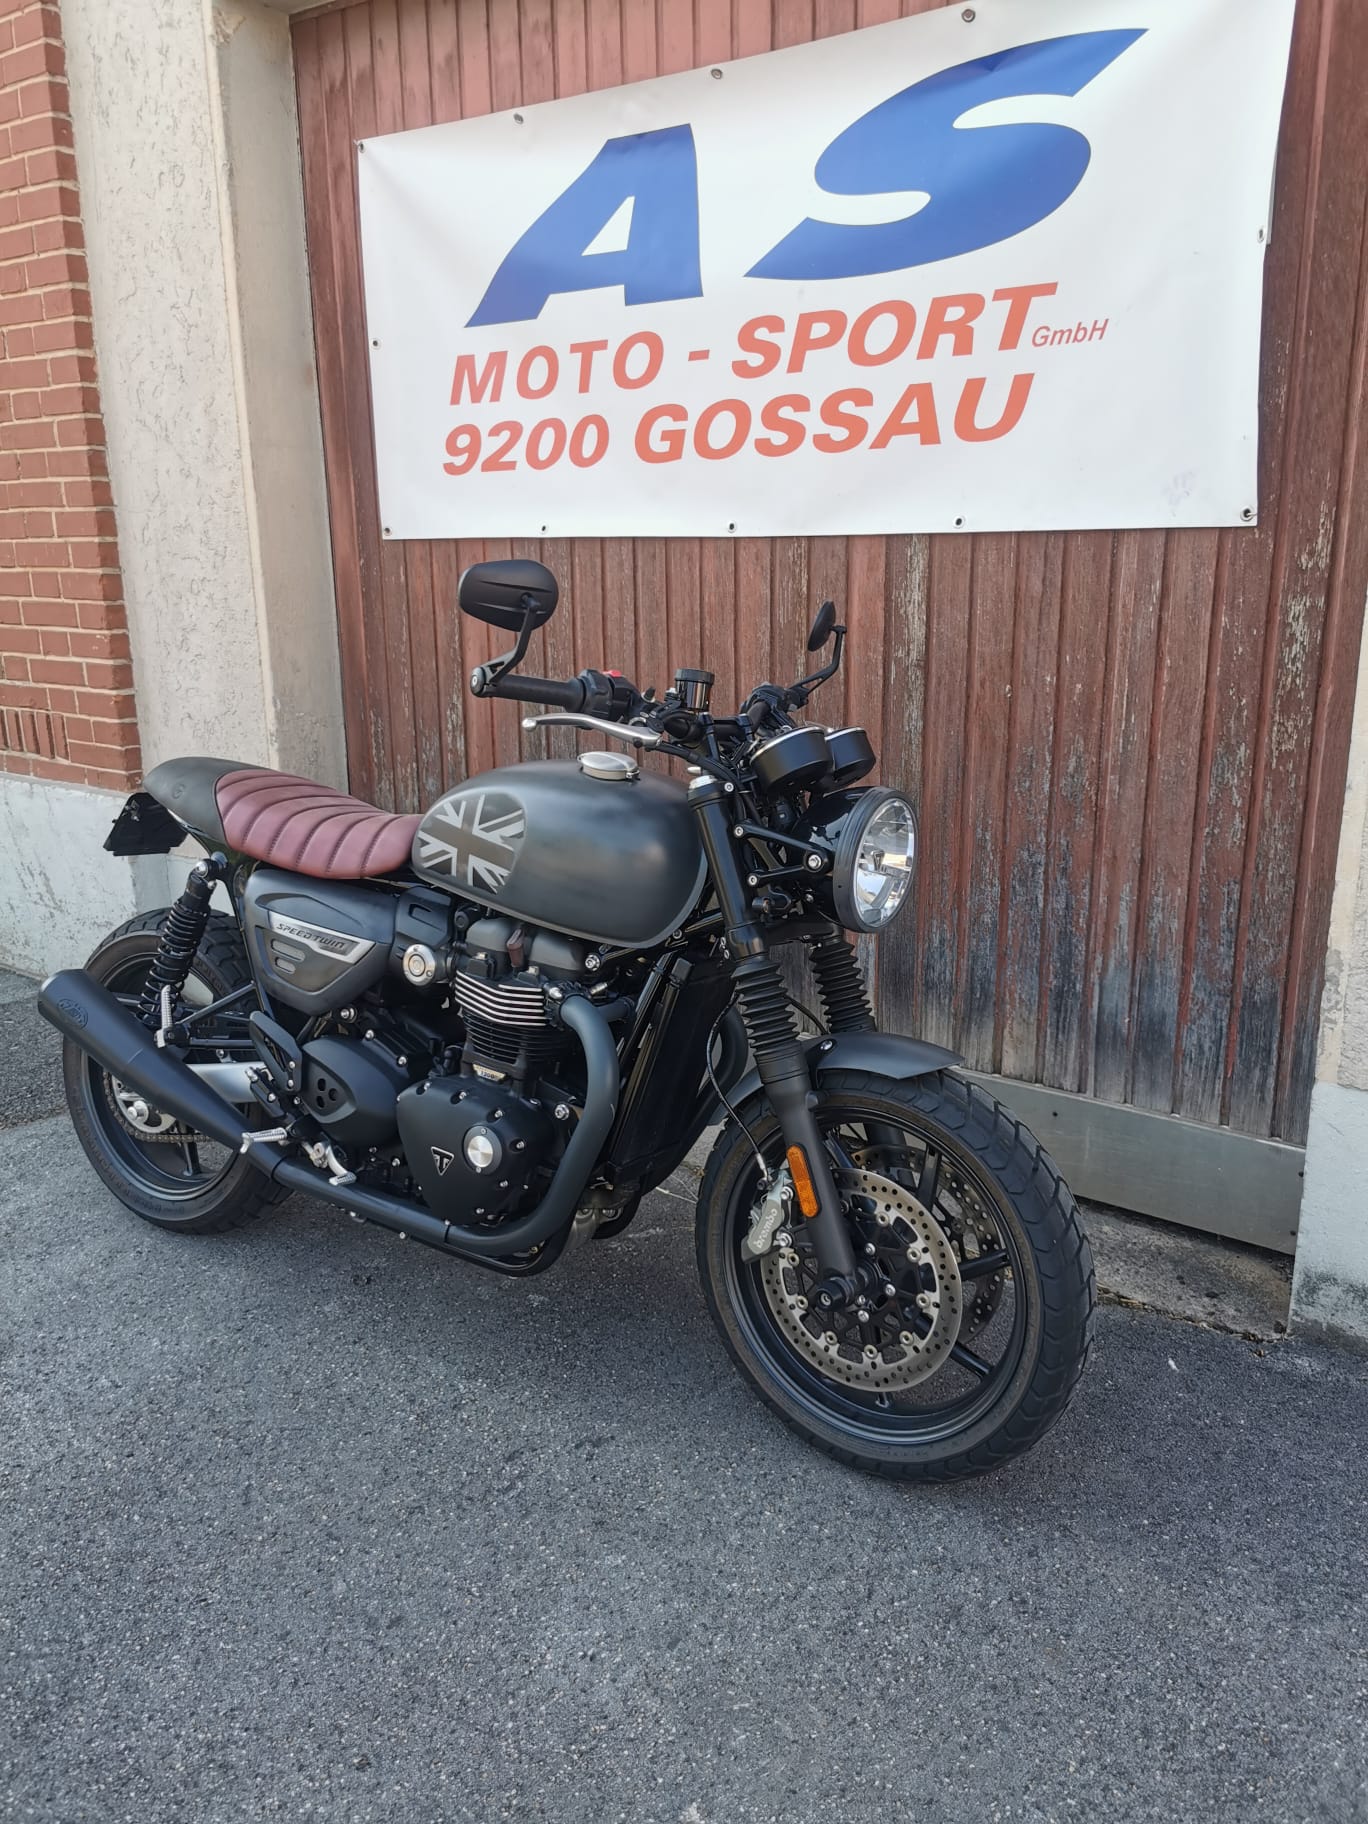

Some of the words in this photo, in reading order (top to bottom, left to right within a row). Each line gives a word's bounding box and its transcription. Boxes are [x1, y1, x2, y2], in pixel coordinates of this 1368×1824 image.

[449, 331, 665, 407] MOTO
[730, 282, 1059, 381] SPORT
[1031, 319, 1108, 348] GmbH
[442, 414, 610, 477] 9200
[634, 373, 1035, 465] GOSSAU
[753, 1208, 778, 1249] brembo
